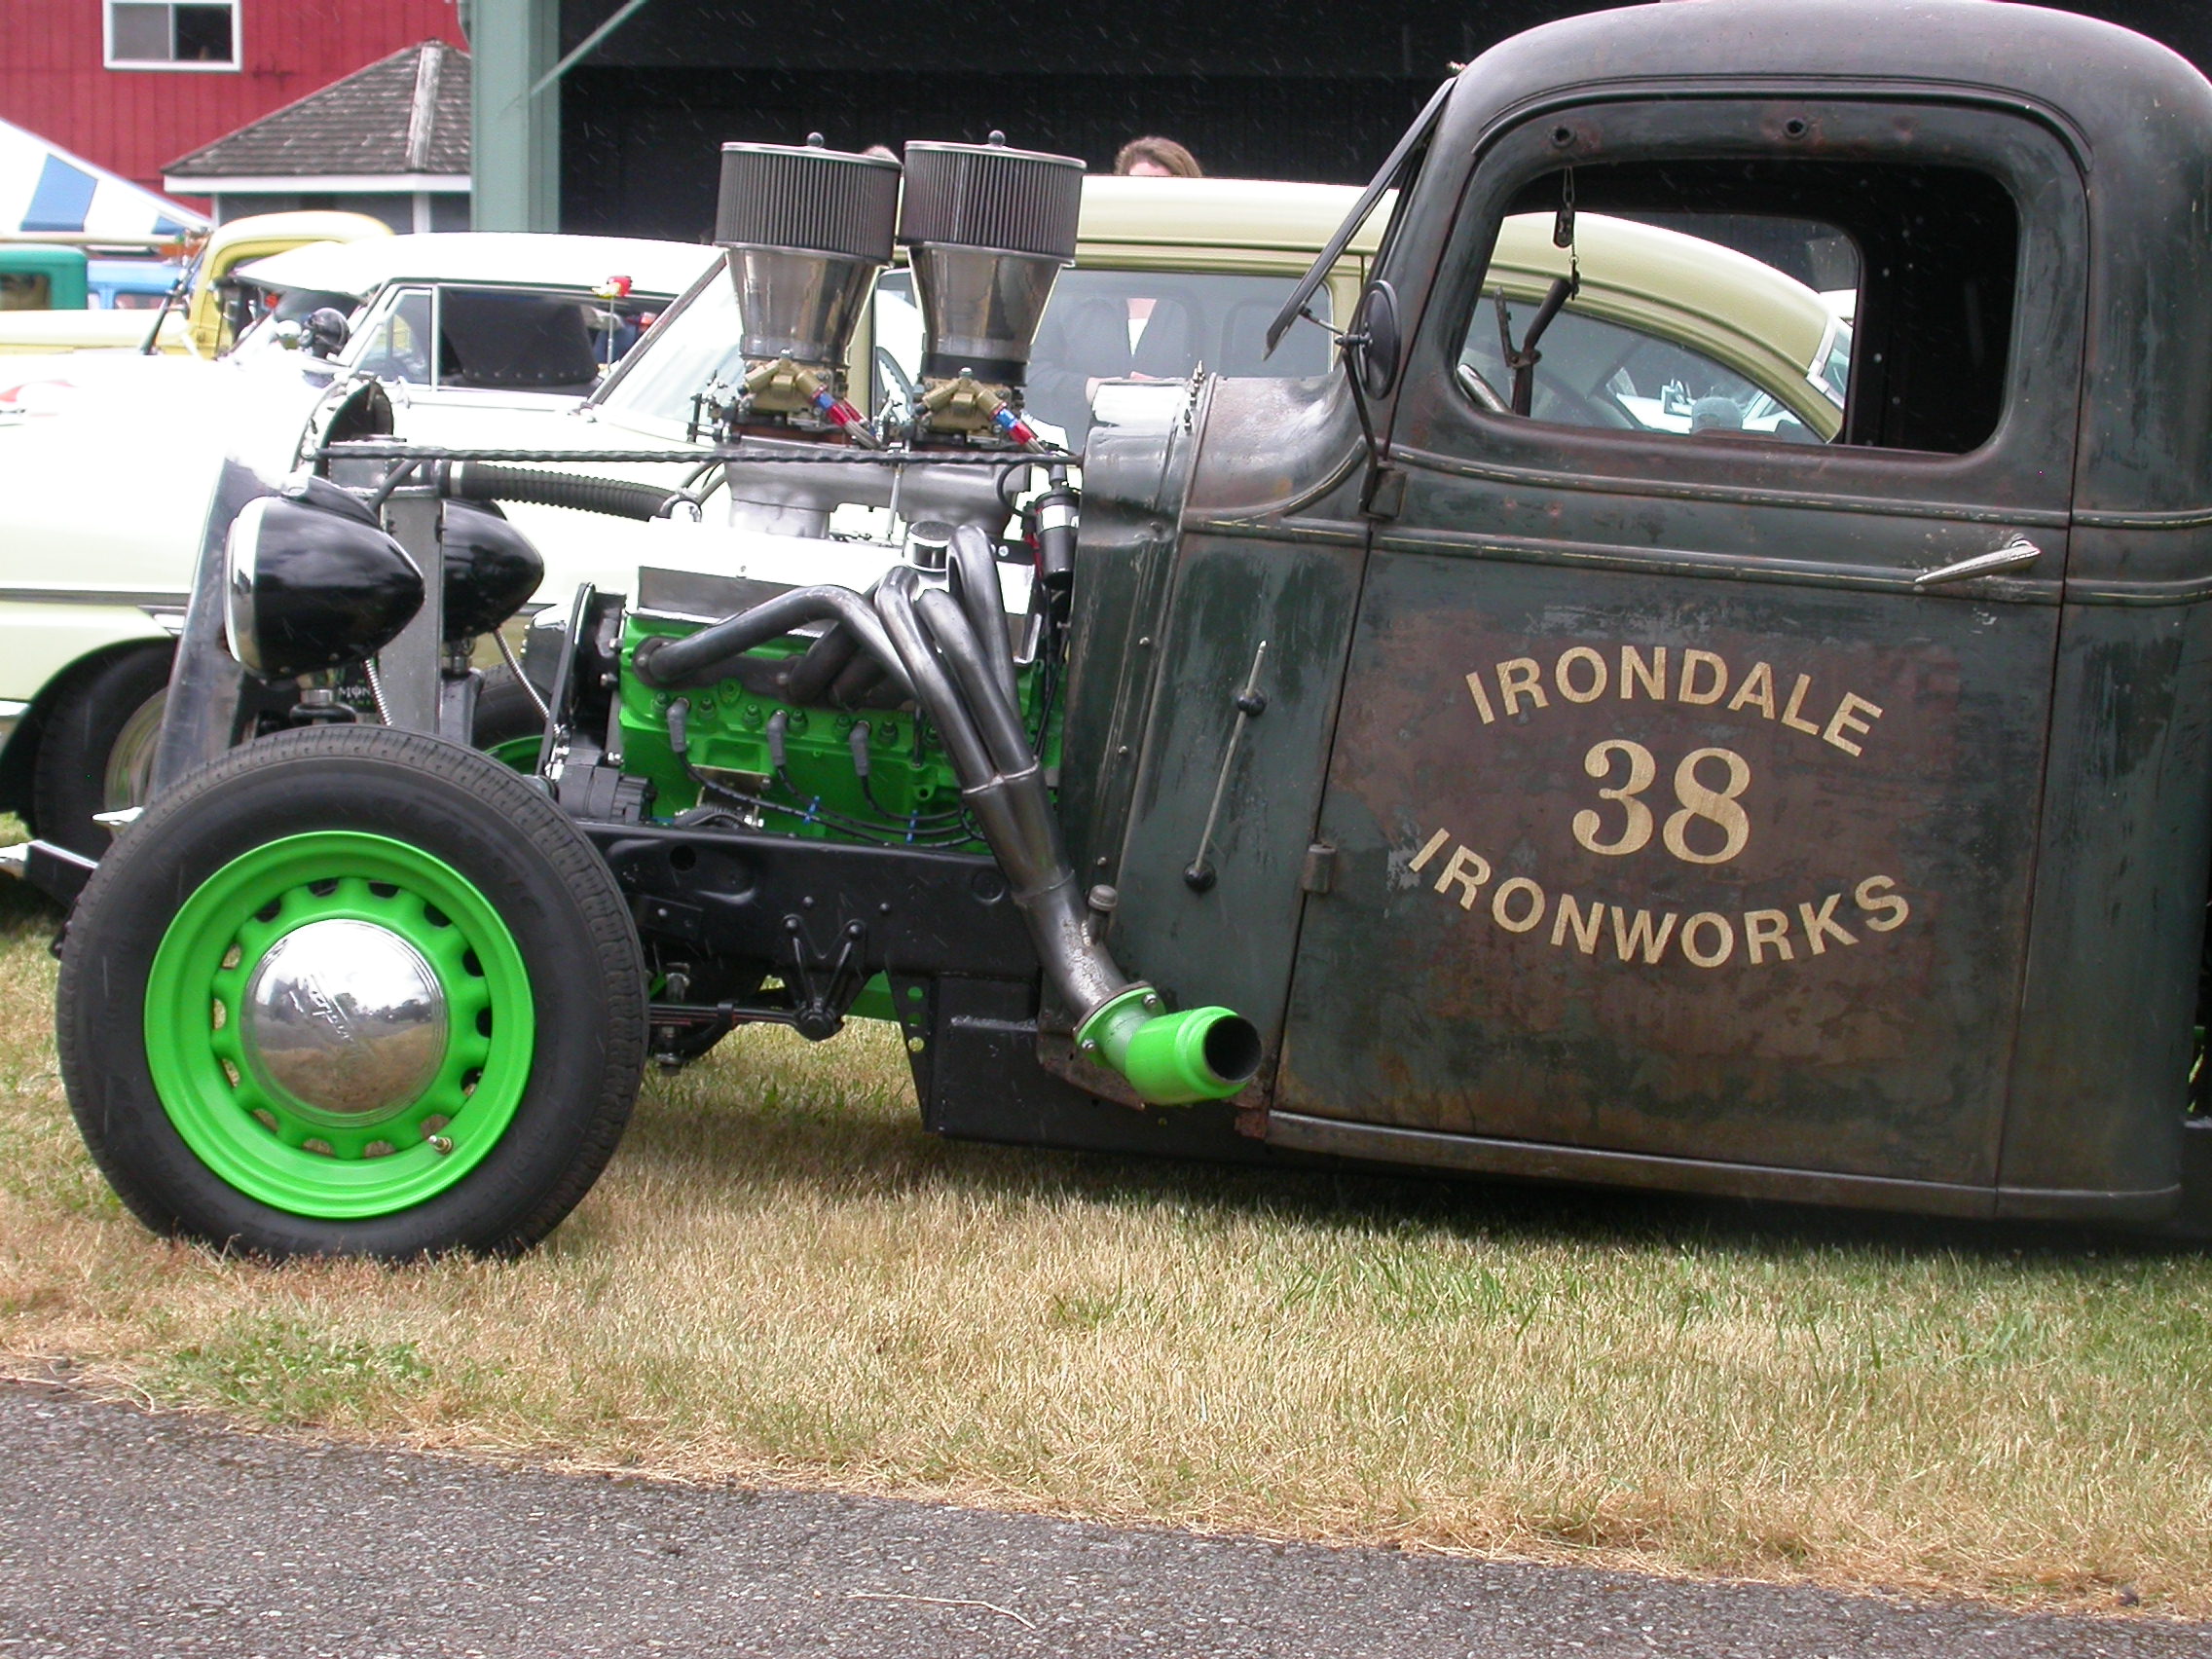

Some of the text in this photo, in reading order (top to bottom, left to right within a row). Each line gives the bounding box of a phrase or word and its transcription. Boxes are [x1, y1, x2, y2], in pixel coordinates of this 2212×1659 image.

[1465, 645, 1883, 757] IRONDALE
[1572, 739, 1751, 865] 38
[1408, 828, 1909, 968] IRONWORKS
